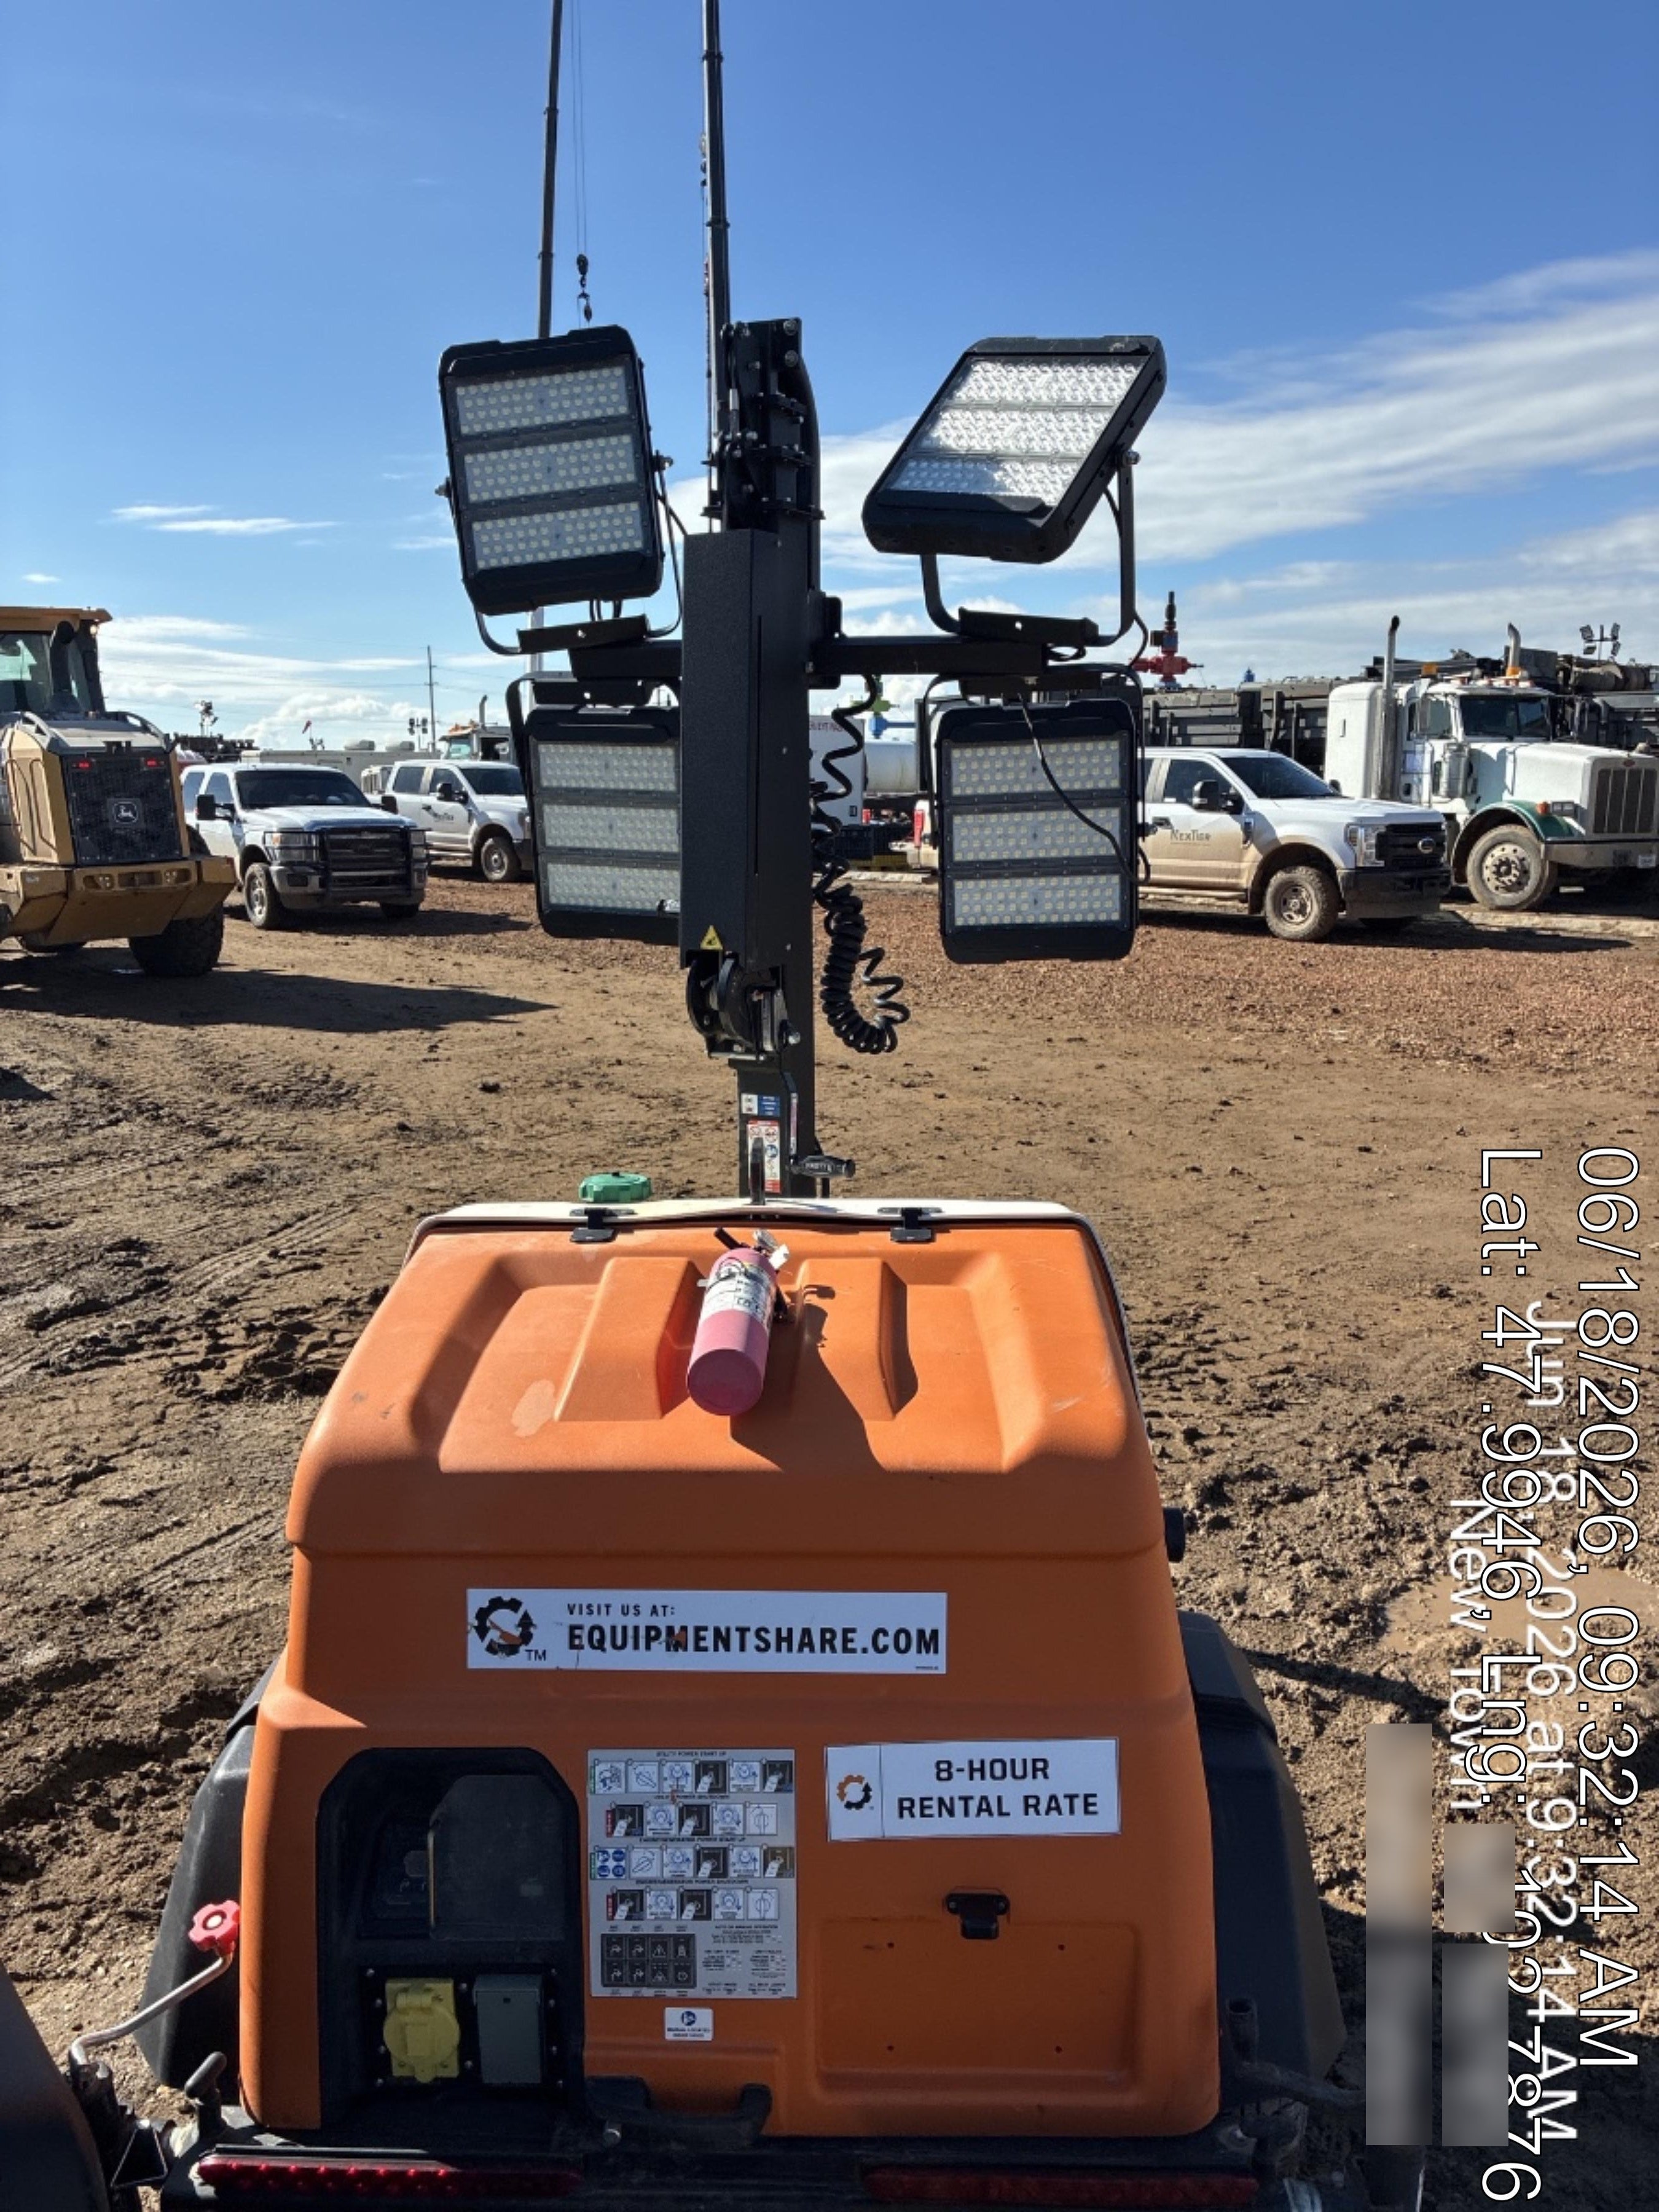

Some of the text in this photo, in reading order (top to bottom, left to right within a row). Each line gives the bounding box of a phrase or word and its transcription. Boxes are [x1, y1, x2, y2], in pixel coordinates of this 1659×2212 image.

[567, 1603, 676, 1617] VISIT US AT:
[568, 1624, 939, 1655] EQUIPMENTSHARE.COM
[935, 1757, 1050, 1782] 8-HOUR
[898, 1792, 1099, 1819] RENTAL RATE
